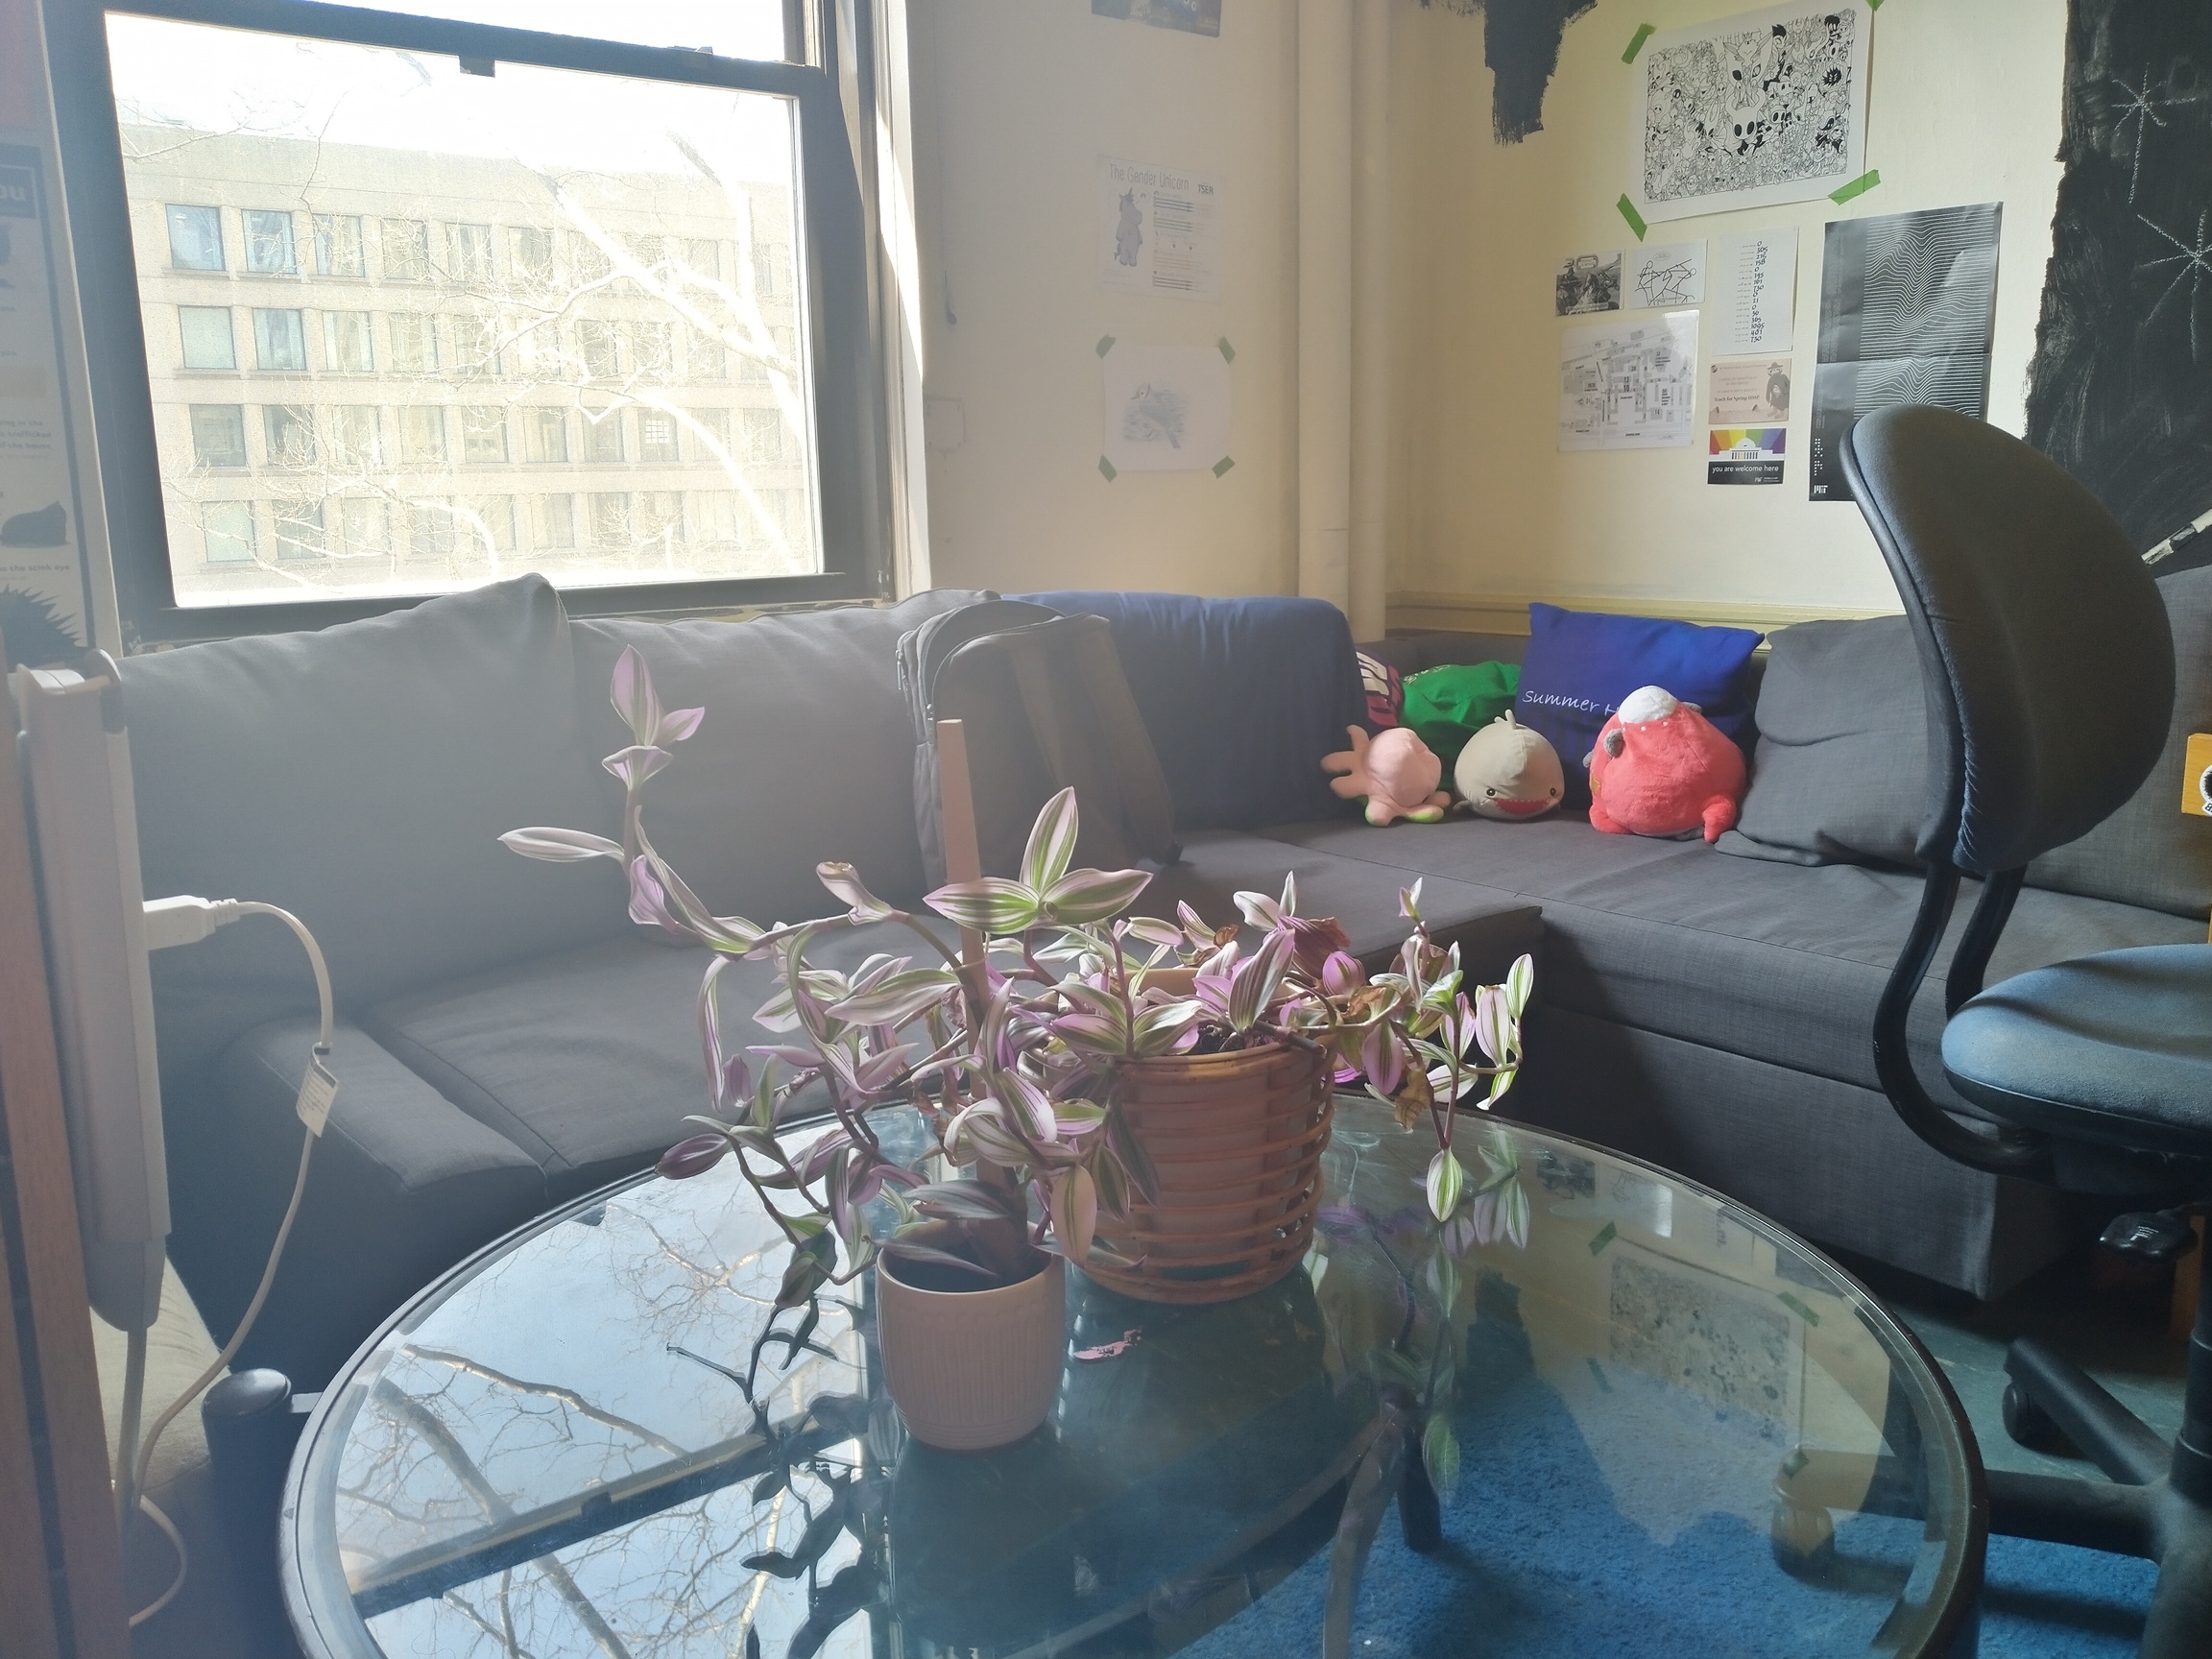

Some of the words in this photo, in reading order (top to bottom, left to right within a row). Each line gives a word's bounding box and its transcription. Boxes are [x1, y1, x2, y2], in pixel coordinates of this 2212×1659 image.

[1110, 163, 1124, 181] The
[1127, 166, 1157, 186] Gender
[1159, 172, 1190, 190] Unicorn
[1197, 183, 1214, 196] TSER
[1712, 466, 1723, 474] you
[1764, 464, 1779, 472] here
